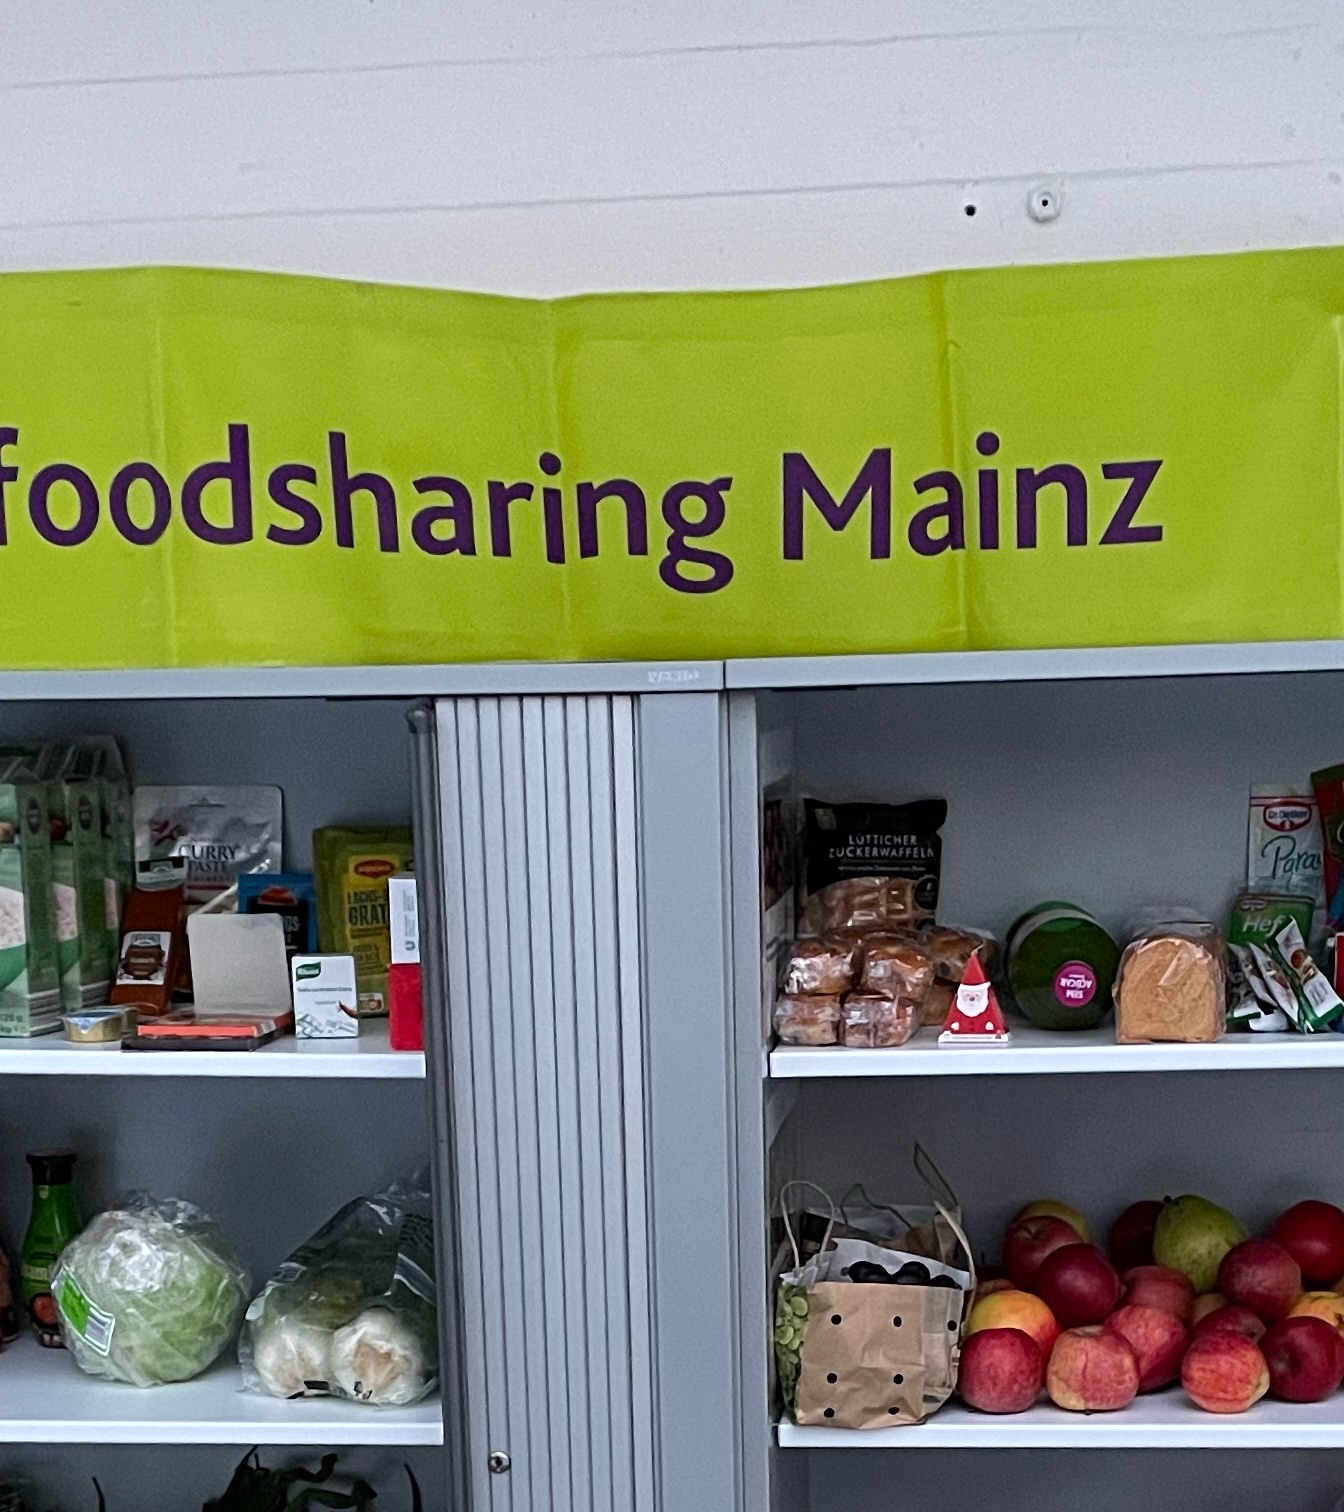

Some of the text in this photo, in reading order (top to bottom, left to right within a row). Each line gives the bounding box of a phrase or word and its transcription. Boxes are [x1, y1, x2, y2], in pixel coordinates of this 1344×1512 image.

[781, 430, 1165, 562] Mainz
[178, 843, 239, 861] CURRY
[828, 846, 935, 859] ZUCKERWAFFELN
